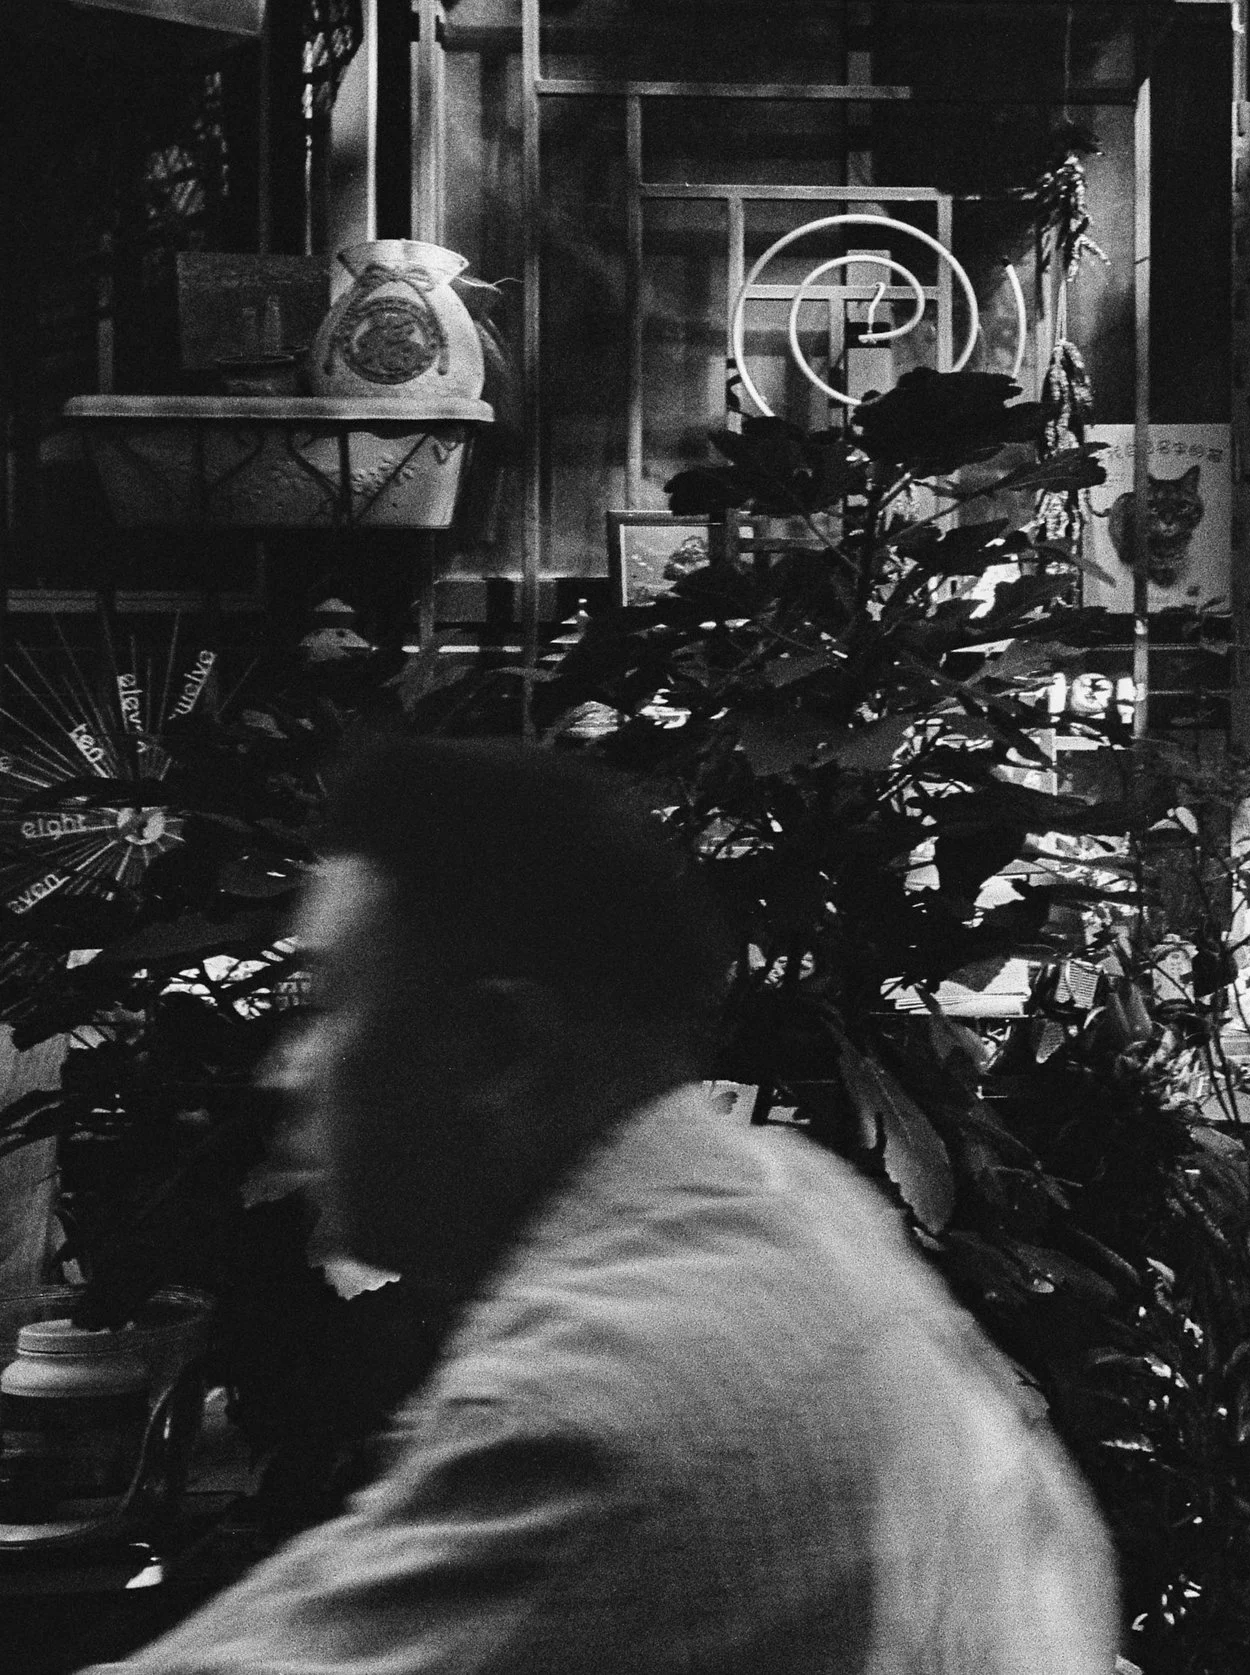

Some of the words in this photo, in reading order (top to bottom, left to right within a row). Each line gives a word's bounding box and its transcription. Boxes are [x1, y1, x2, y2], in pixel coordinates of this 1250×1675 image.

[116, 673, 149, 753] elevn
[69, 722, 105, 766] ten
[20, 811, 88, 841] eight
[6, 873, 61, 915] even
